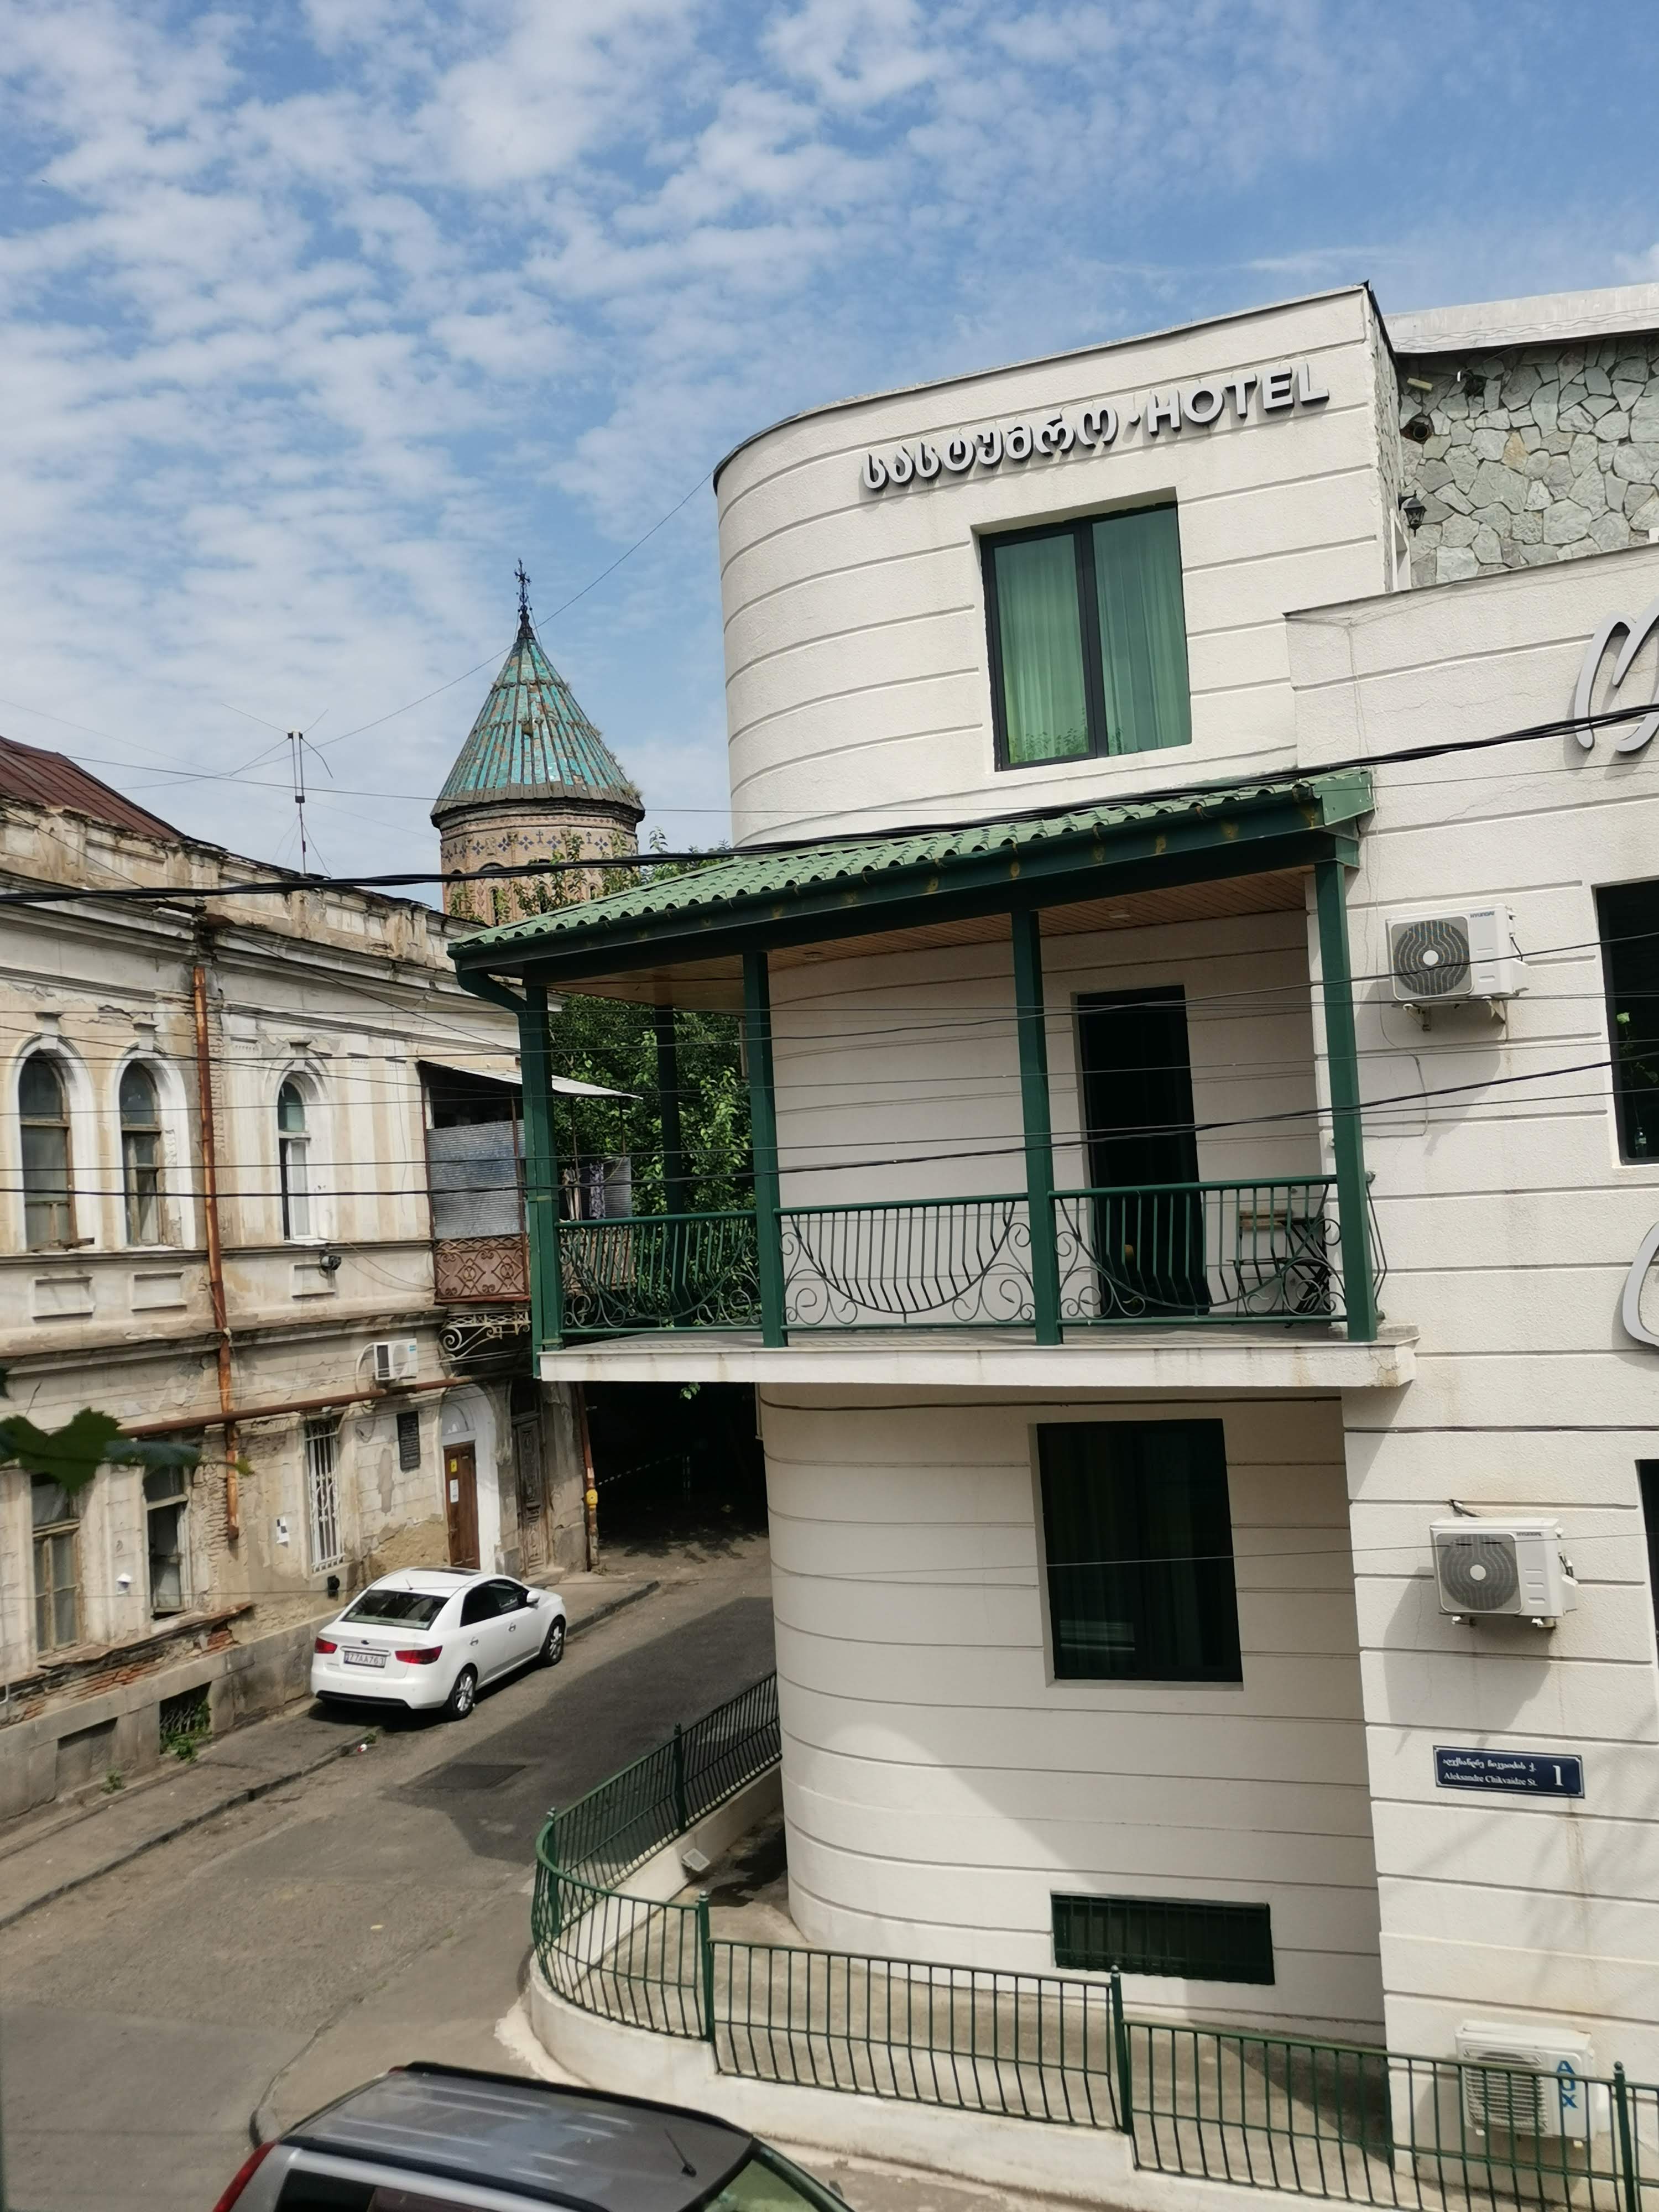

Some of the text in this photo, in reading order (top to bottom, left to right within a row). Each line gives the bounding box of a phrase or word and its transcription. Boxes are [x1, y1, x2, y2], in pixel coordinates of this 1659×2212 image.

[1146, 363, 1330, 436] HOTEL
[863, 405, 1119, 491] სასტუმრო
[1444, 1772, 1484, 1782] Aleksandre
[1485, 1775, 1526, 1786] Chikvaidze
[1552, 1765, 1564, 1787] 1
